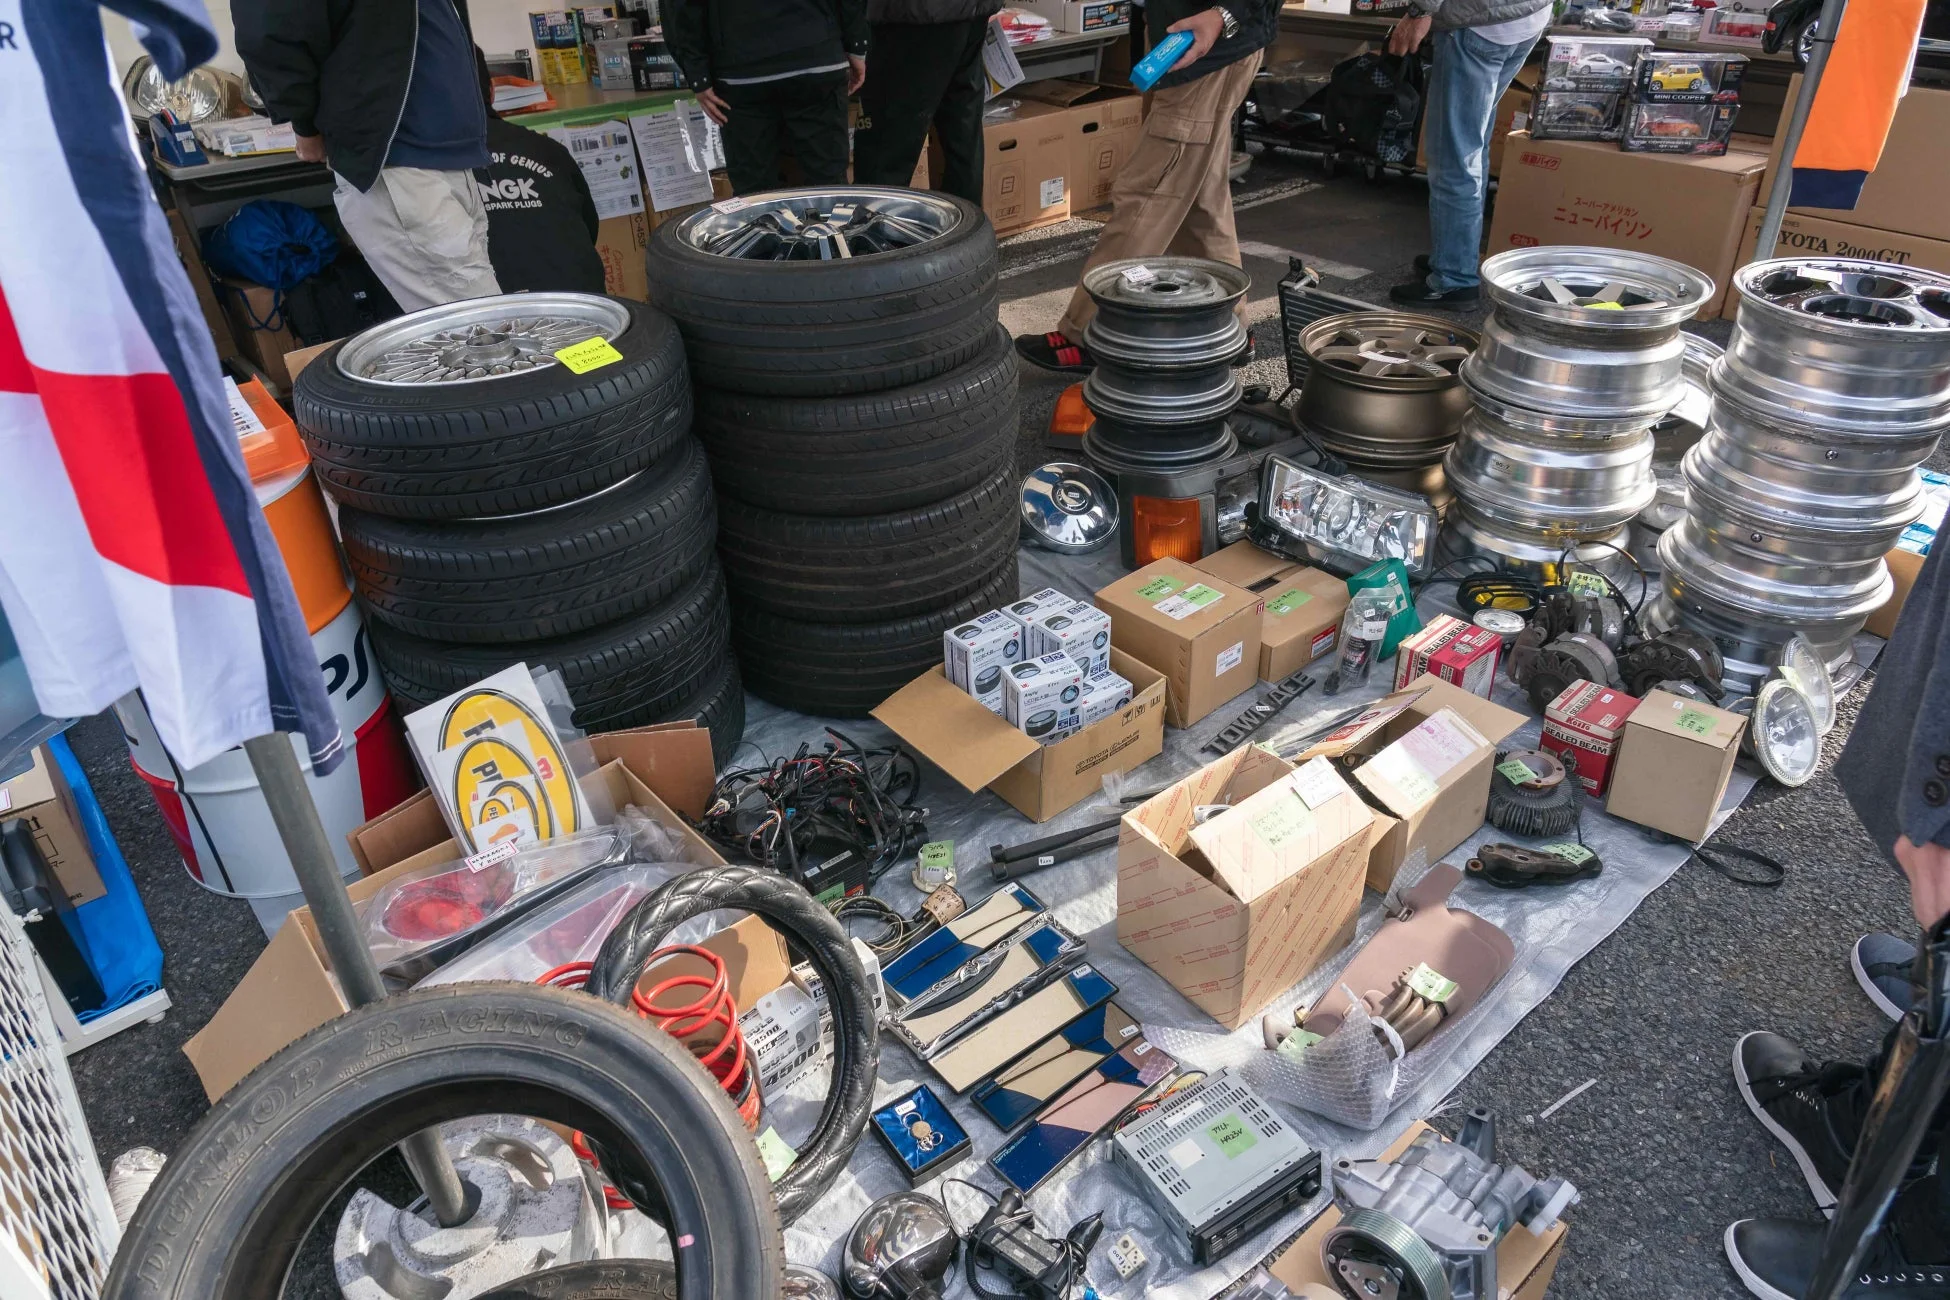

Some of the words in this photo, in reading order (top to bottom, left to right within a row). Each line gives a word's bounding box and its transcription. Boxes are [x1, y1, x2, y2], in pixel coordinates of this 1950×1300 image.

[491, 152, 506, 163] OF
[510, 154, 554, 178] GENIUS
[477, 178, 539, 202] NGK
[484, 202, 514, 211] SPARK
[515, 200, 543, 209] PLUGS
[1574, 197, 1639, 217] スーパーアメリカン
[1554, 208, 1653, 240] ニューバイソン
[1754, 226, 1829, 253] TYOTA
[1835, 241, 1911, 265] 2000GT
[1424, 635, 1450, 655] SEALED
[1448, 622, 1470, 638] BEAM
[1569, 697, 1590, 716] SEALED
[1586, 685, 1604, 700] BEAM
[1544, 726, 1578, 745] SEALED
[1579, 740, 1608, 755] BEAM
[366, 1007, 588, 1056] RACING
[753, 1023, 782, 1046] 4500
[764, 1041, 821, 1088] 4500
[785, 1071, 808, 1090] PIAA
[136, 1058, 324, 1291] DUNLOP
